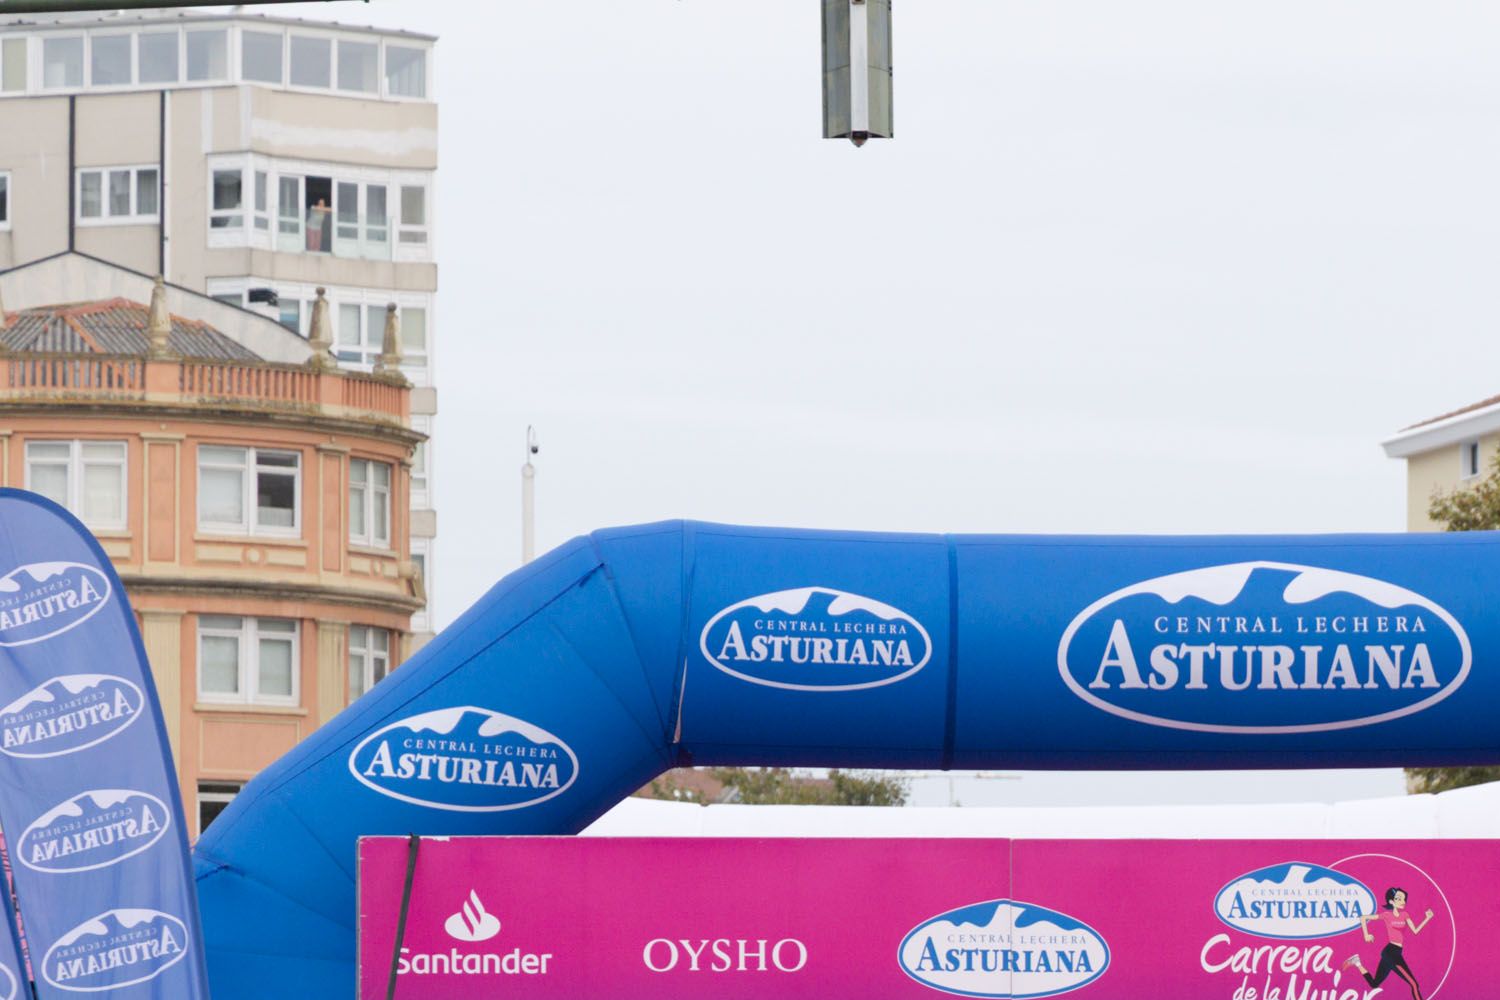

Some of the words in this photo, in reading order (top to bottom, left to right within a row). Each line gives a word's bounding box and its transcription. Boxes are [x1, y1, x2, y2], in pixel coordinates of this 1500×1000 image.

[755, 618, 827, 632] CENTRAL
[833, 621, 907, 634] LECHERA
[1155, 616, 1282, 633] CENTRAL
[1297, 616, 1426, 633] LECHERA
[717, 620, 914, 667] ASTURIANA
[1088, 619, 1440, 691] ASTURIANA
[404, 738, 476, 755] CENTRAL
[484, 743, 558, 759] LECHERA
[364, 740, 560, 789] ASTURIANA
[1227, 891, 1363, 918] ASTURIANA
[1252, 888, 1303, 896] CENTRAL
[1307, 888, 1359, 896] LECHERA
[947, 933, 1013, 944] CENTRAL
[1020, 933, 1088, 945] LECHERA
[396, 947, 552, 975] Santander
[643, 938, 807, 972] OYSHO
[915, 936, 1093, 973] ASTURIANA
[1200, 933, 1333, 974] Carrera
